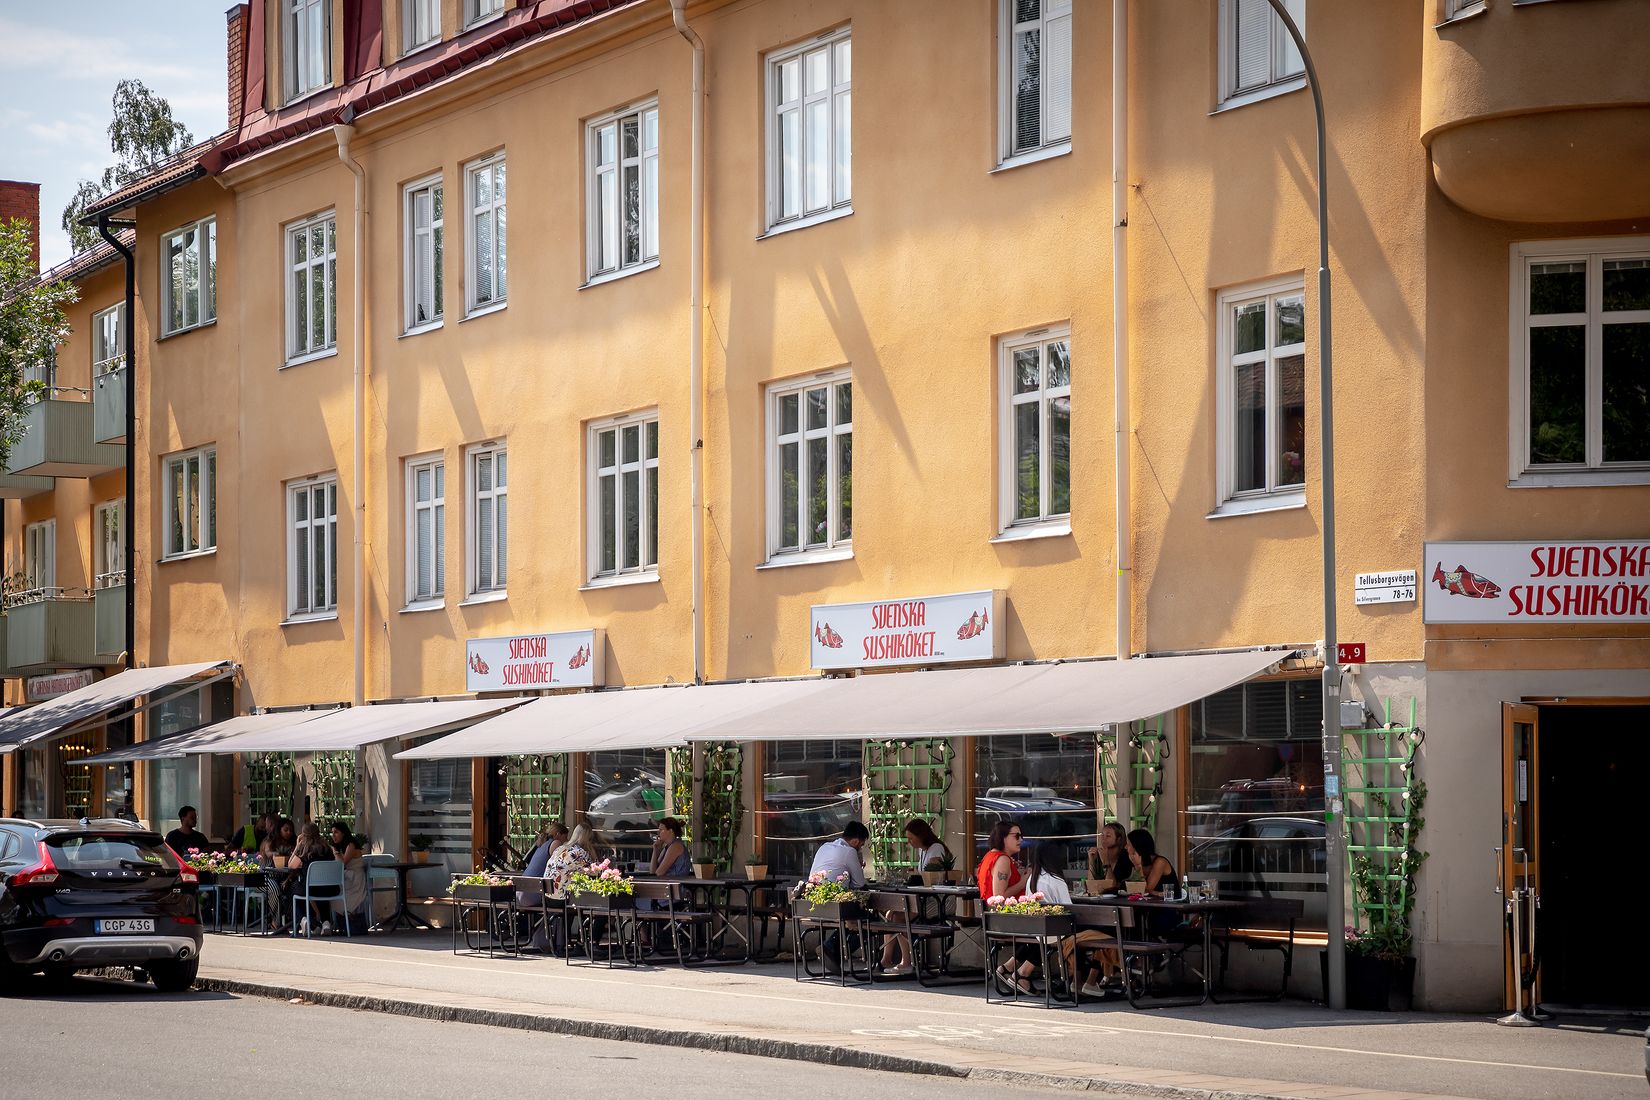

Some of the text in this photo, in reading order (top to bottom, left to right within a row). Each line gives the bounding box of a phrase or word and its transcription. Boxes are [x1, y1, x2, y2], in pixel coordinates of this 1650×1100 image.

[1359, 574, 1414, 585] Tellusborgsvägen
[1393, 589, 1413, 599] 78-76
[871, 601, 926, 630] SVENSKA
[509, 636, 547, 660] SVENSKA
[862, 631, 936, 661] SUSHIKÖKET
[502, 661, 554, 685] SUSHIKÖKET
[104, 920, 151, 931] CGP 43G
